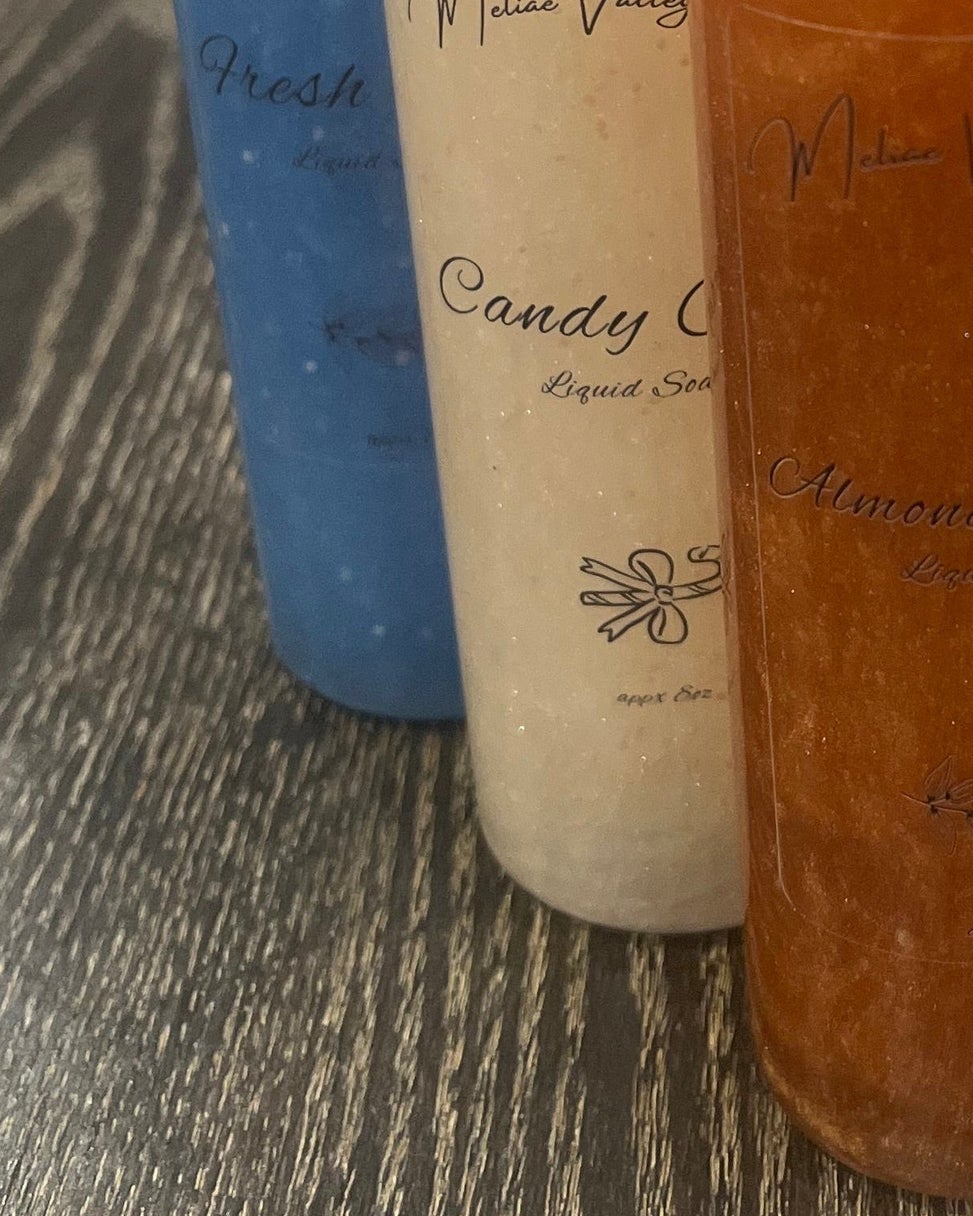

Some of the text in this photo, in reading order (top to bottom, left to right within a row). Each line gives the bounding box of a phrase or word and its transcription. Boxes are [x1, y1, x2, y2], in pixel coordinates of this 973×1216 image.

[200, 35, 371, 109] Fresh
[439, 256, 649, 355] Candy
[542, 370, 644, 405] Liquid
